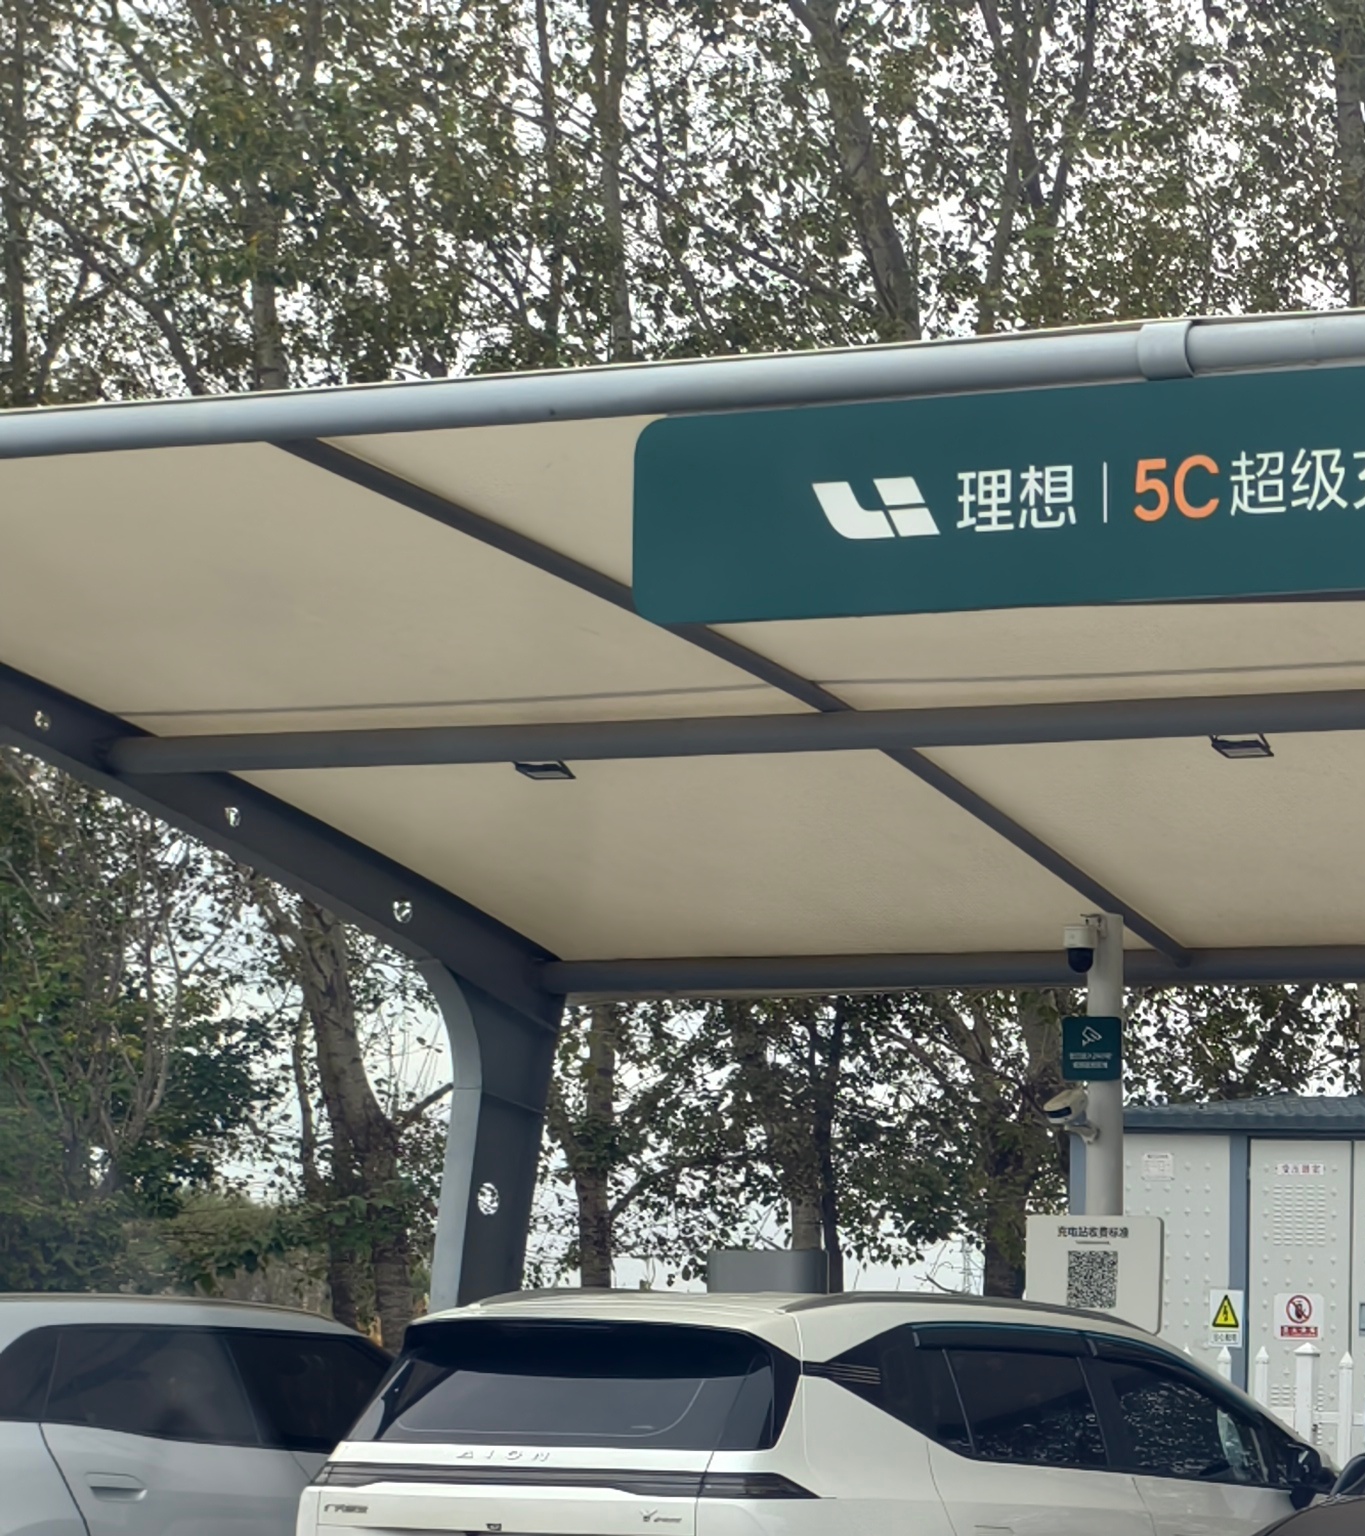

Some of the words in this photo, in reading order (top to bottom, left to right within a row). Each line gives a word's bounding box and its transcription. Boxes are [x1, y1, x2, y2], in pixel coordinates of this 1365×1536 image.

[955, 461, 1077, 534] 理想
[1057, 1226, 1129, 1239] 充电站收费标准
[455, 1450, 552, 1462] AION
